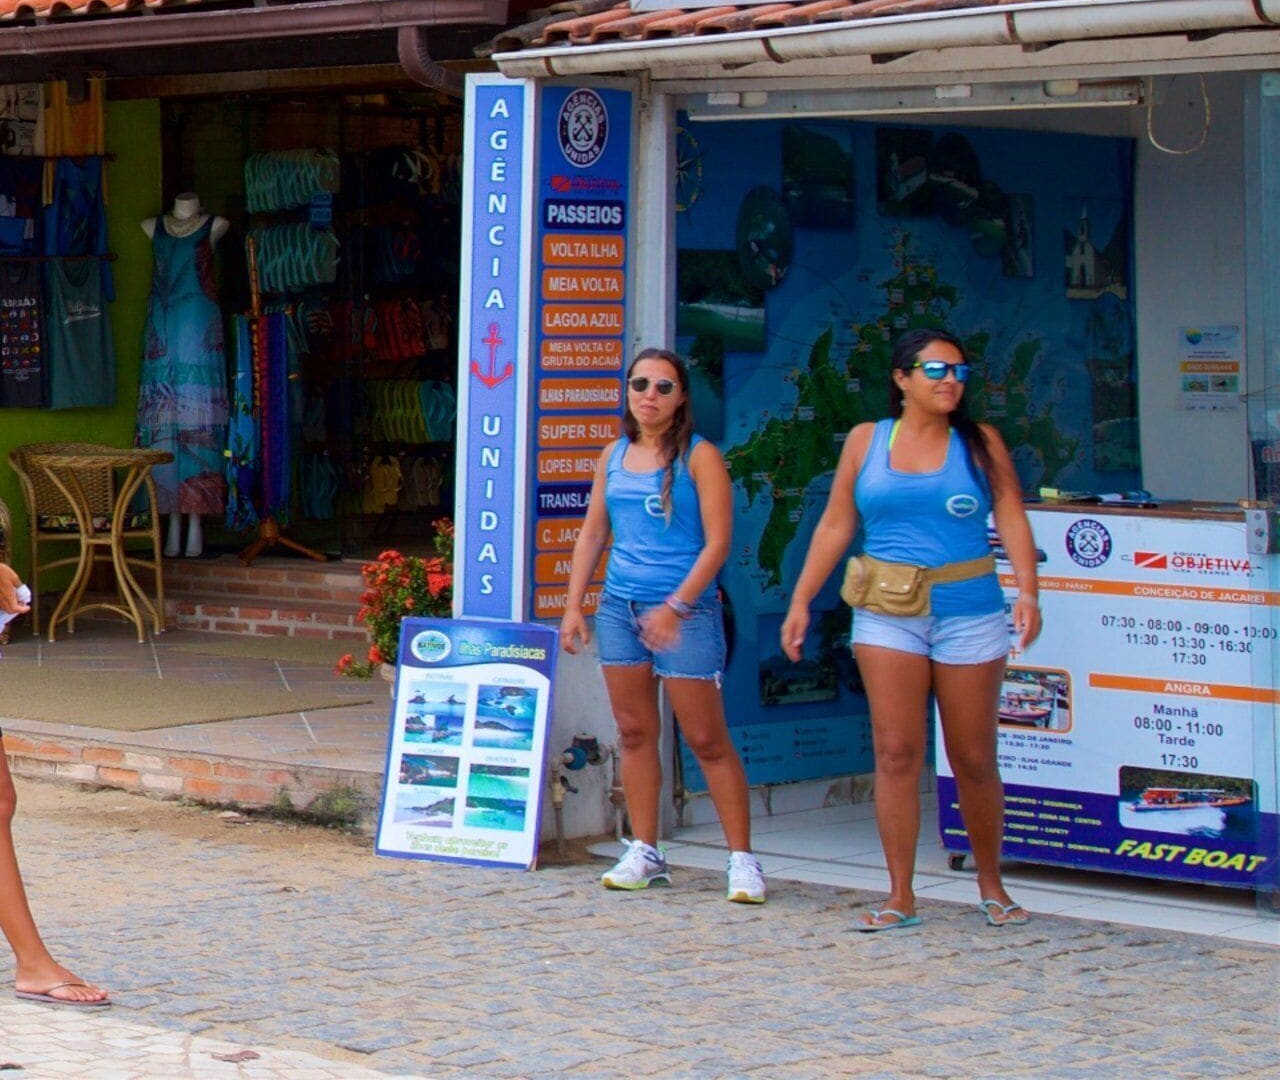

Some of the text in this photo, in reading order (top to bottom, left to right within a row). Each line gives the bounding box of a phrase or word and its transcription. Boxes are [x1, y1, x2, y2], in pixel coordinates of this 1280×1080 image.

[547, 204, 622, 225] PASSEIOS
[550, 243, 619, 258] VOLTA ILHA
[549, 277, 619, 292] MEIA VOLTA
[545, 313, 621, 328] LAGOA AZUL
[477, 98, 509, 596] AGÊNCIA UNIDAS
[549, 342, 615, 353] MEIA VOLTA C/
[543, 355, 575, 367] GRUTA
[576, 356, 590, 367] DO
[541, 388, 564, 403] ILHAS
[540, 424, 616, 439] SUPER SUL
[540, 459, 573, 473] LOPES
[539, 493, 590, 508] TRANSLA
[542, 529, 555, 544] C.
[1072, 553, 1107, 568] UNIDAS
[1171, 555, 1252, 572] OBJETIVA
[1133, 585, 1198, 600] CONCEIÇÃO
[1200, 591, 1215, 601] DE
[1101, 615, 1136, 629] 07:30
[1147, 619, 1182, 632] 08:00
[1194, 623, 1230, 636] 09:00
[1125, 632, 1159, 646] 11:30
[1171, 636, 1206, 650] 13:30
[1171, 652, 1207, 666] 17:30
[1164, 682, 1211, 696] ANGRA
[1153, 703, 1199, 718] Manhã
[1133, 716, 1224, 737] 08:00 11:00
[1157, 733, 1196, 747] Tarde
[1160, 753, 1199, 769] 17:30
[1114, 839, 1268, 872] FAST BOAT
